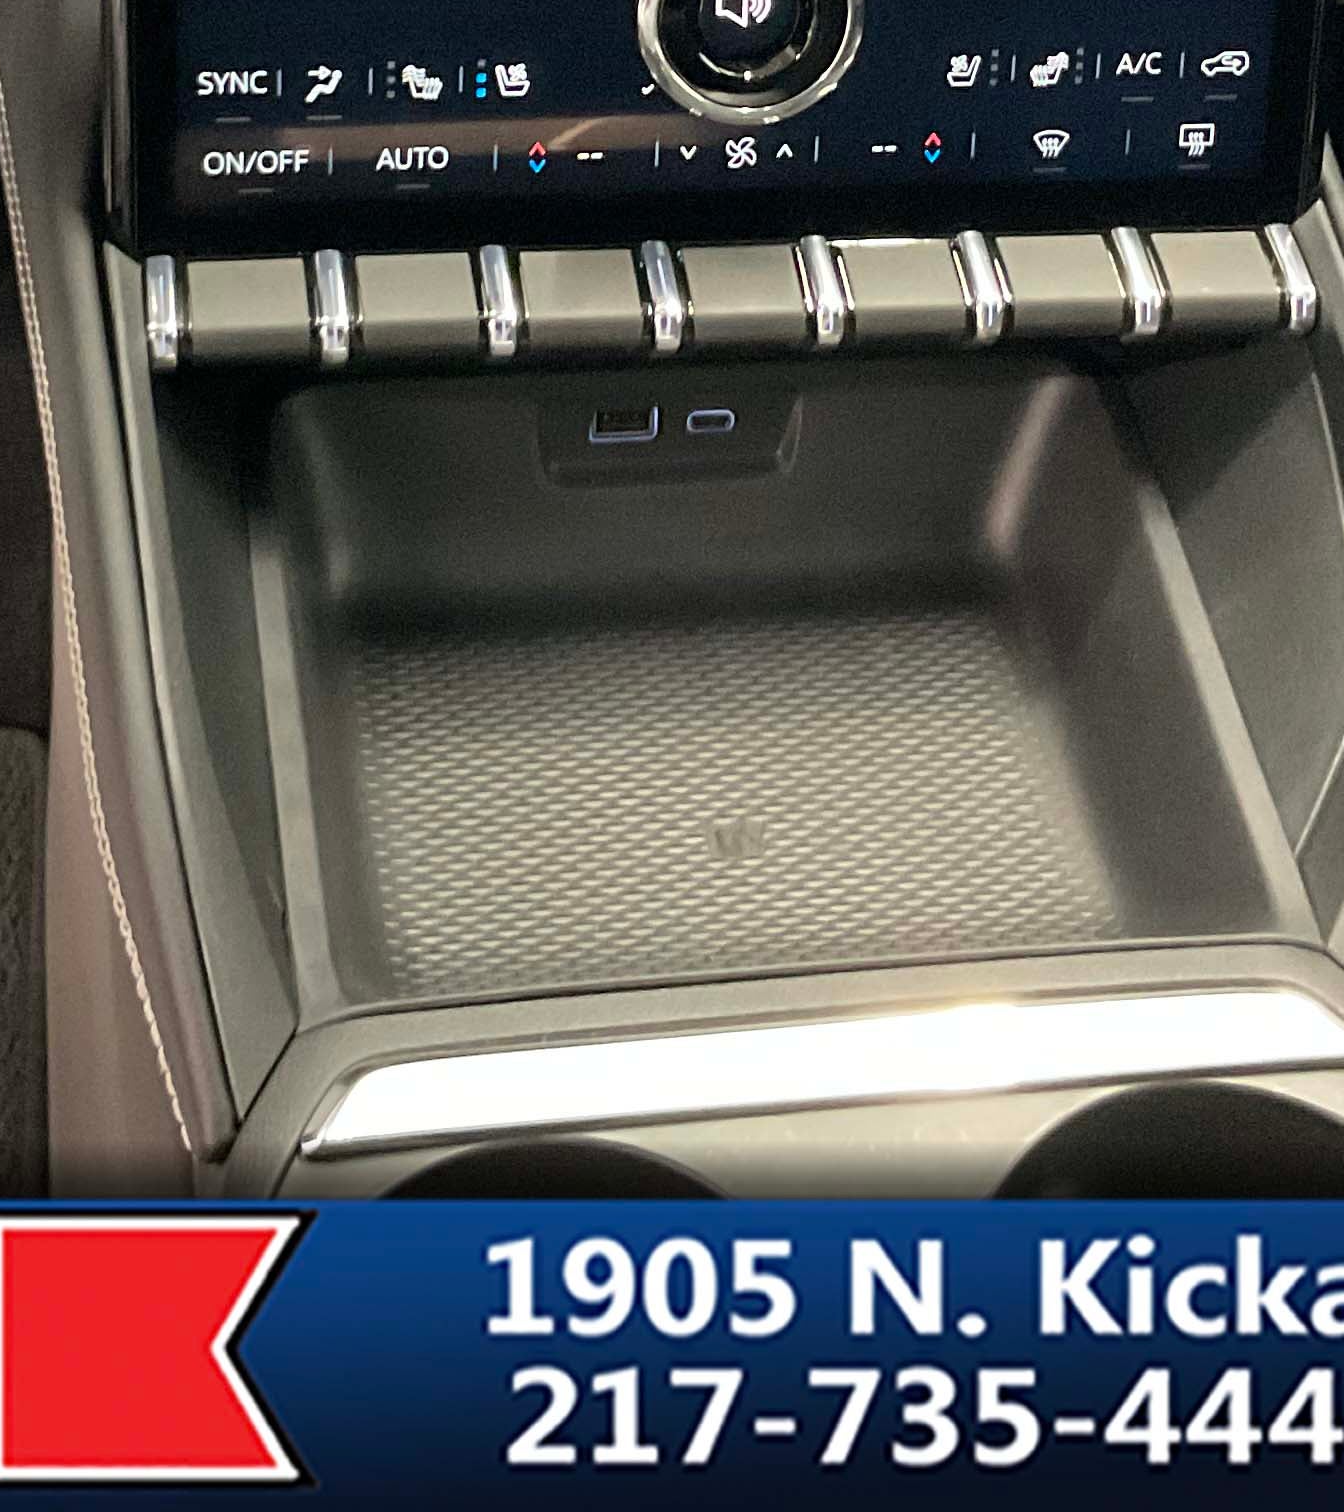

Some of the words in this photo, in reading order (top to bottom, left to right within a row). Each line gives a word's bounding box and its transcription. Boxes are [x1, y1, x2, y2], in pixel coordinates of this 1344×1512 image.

[1115, 51, 1162, 76] A/C
[196, 70, 268, 96] SYNC
[203, 149, 310, 176] ON/OFF
[375, 146, 449, 171] AUTO
